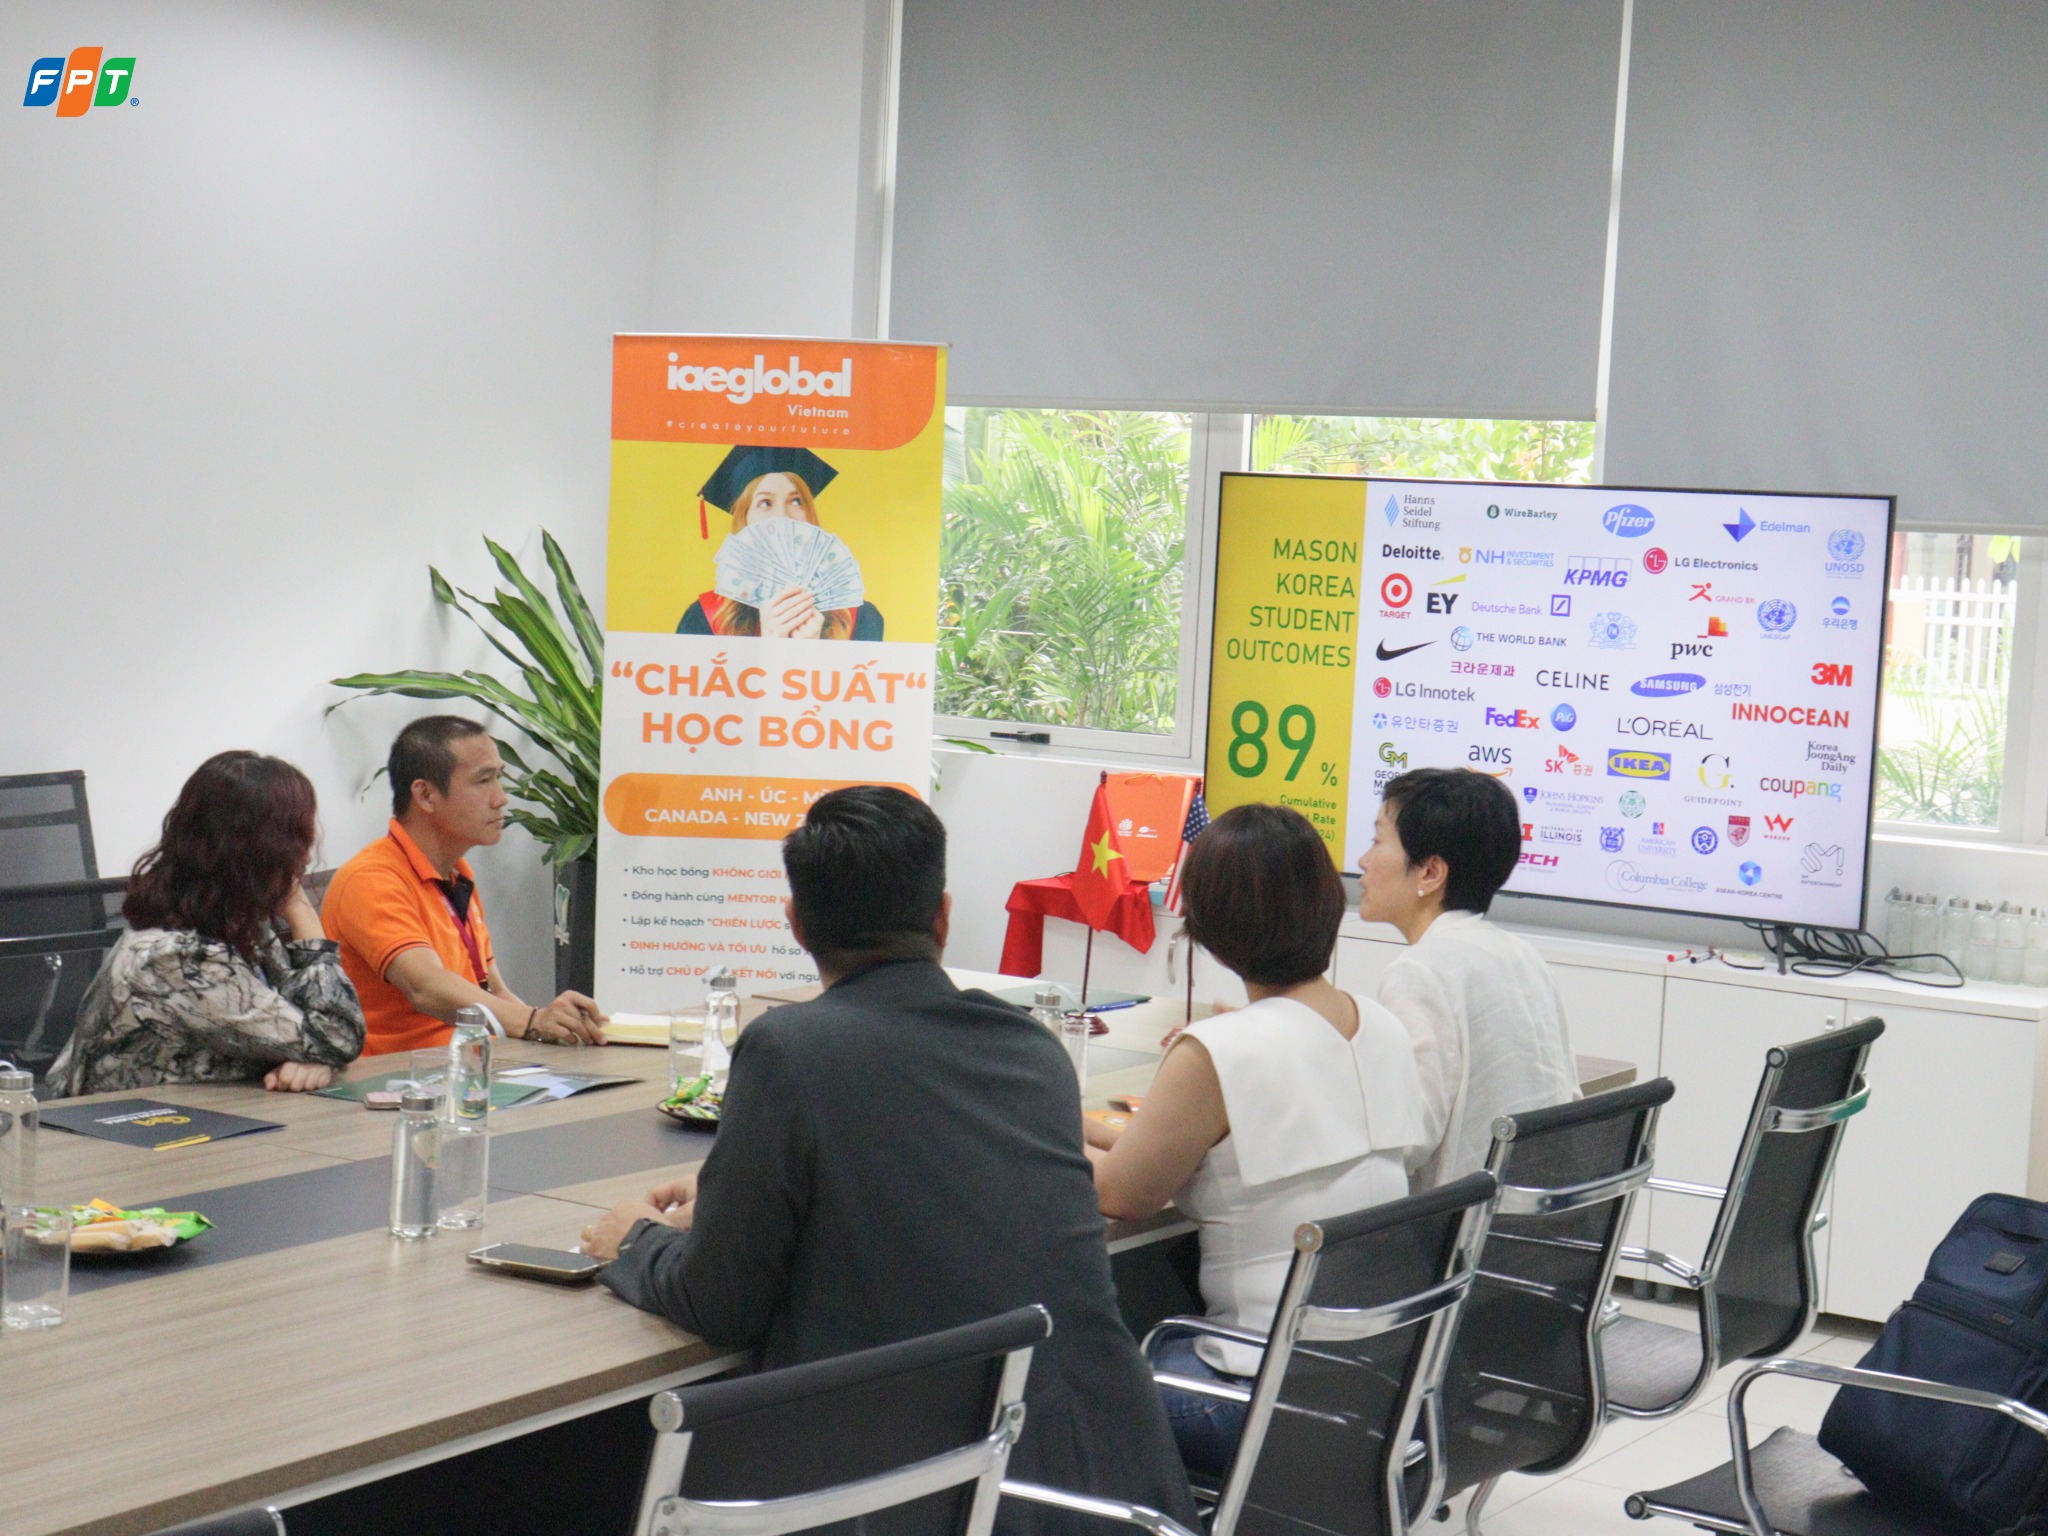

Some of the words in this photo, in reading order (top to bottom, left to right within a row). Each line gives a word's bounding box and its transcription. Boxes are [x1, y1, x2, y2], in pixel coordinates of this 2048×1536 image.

[667, 352, 852, 404] iaeglobal
[787, 404, 848, 419] Vietnam
[1403, 494, 1435, 505] Hanns
[1403, 506, 1432, 516] Seidel
[1504, 508, 1558, 520] WireBarley
[1402, 518, 1440, 530] Stiftung
[1604, 507, 1654, 536] Pfizer
[1760, 521, 1811, 533] Edelman
[1274, 538, 1357, 563] MASON
[1475, 549, 1505, 564] NH
[1507, 551, 1555, 560] INVESTMENT
[1514, 558, 1554, 567] SECURITIES
[1674, 558, 1690, 568] LG
[1693, 559, 1759, 571] Electronics
[1825, 562, 1864, 573] UNOSD
[1564, 569, 1628, 587] KPMG
[1277, 573, 1355, 598] KOREA
[1427, 592, 1458, 614] EY
[1715, 596, 1744, 604] GRAND
[1379, 610, 1411, 619] TARGET
[1472, 601, 1516, 614] Deutsche
[1519, 605, 1542, 615] Bank
[1250, 606, 1355, 632] STUDENT
[1822, 618, 1857, 630] 우리은행
[1476, 633, 1495, 643] THE
[1498, 634, 1536, 645] WORLD
[1538, 637, 1567, 647] BANK
[1227, 638, 1350, 668] OUTCOMES
[1670, 642, 1713, 660] pwc
[1450, 661, 1516, 677] 크라운제과
[1811, 663, 1853, 687] 3M
[1536, 670, 1610, 691] CELINE
[1639, 678, 1697, 692] SAMSUNG
[1395, 682, 1416, 697] LG
[1419, 684, 1475, 702] Innotek
[1714, 683, 1752, 697] 삼성전기
[1486, 707, 1540, 729] FedEx
[1555, 712, 1574, 723] P&G
[1732, 703, 1849, 728] INNOCEAN
[642, 712, 743, 754] HỌC
[759, 705, 893, 752] BỔNG
[1391, 715, 1459, 733] 유안타증권
[1808, 741, 1838, 752] Korea
[1468, 745, 1512, 764] aws
[1805, 750, 1856, 764] JoongAng
[1545, 760, 1563, 773] SK
[1573, 764, 1593, 776] 증권
[1613, 757, 1666, 772] IKEA
[1821, 762, 1849, 774] Daily
[700, 787, 742, 802] ANH
[760, 786, 786, 804] ÚC
[1760, 777, 1843, 803] coupang
[1280, 795, 1337, 809] Cumulative
[1684, 795, 1743, 807] GUIDEPOINT
[645, 809, 727, 824] CANADA
[745, 811, 791, 826] NEW
[1313, 813, 1335, 824] Rate
[1540, 831, 1582, 842] ILLINOIS
[632, 866, 654, 876] Kho
[657, 868, 678, 877] học
[712, 868, 754, 878] KHÔNG
[1621, 871, 1669, 885] Columbia
[1671, 876, 1708, 892] College
[665, 892, 693, 901] hành
[696, 893, 724, 903] cùng
[728, 895, 776, 903] MENTOR
[671, 918, 704, 927] hoạch
[630, 941, 660, 951] ĐỊNH
[709, 942, 725, 952] VÀ
[728, 941, 747, 953] TỐI
[750, 944, 767, 953] ƯU
[732, 968, 753, 978] KẾT
[756, 968, 777, 979] NỐI
